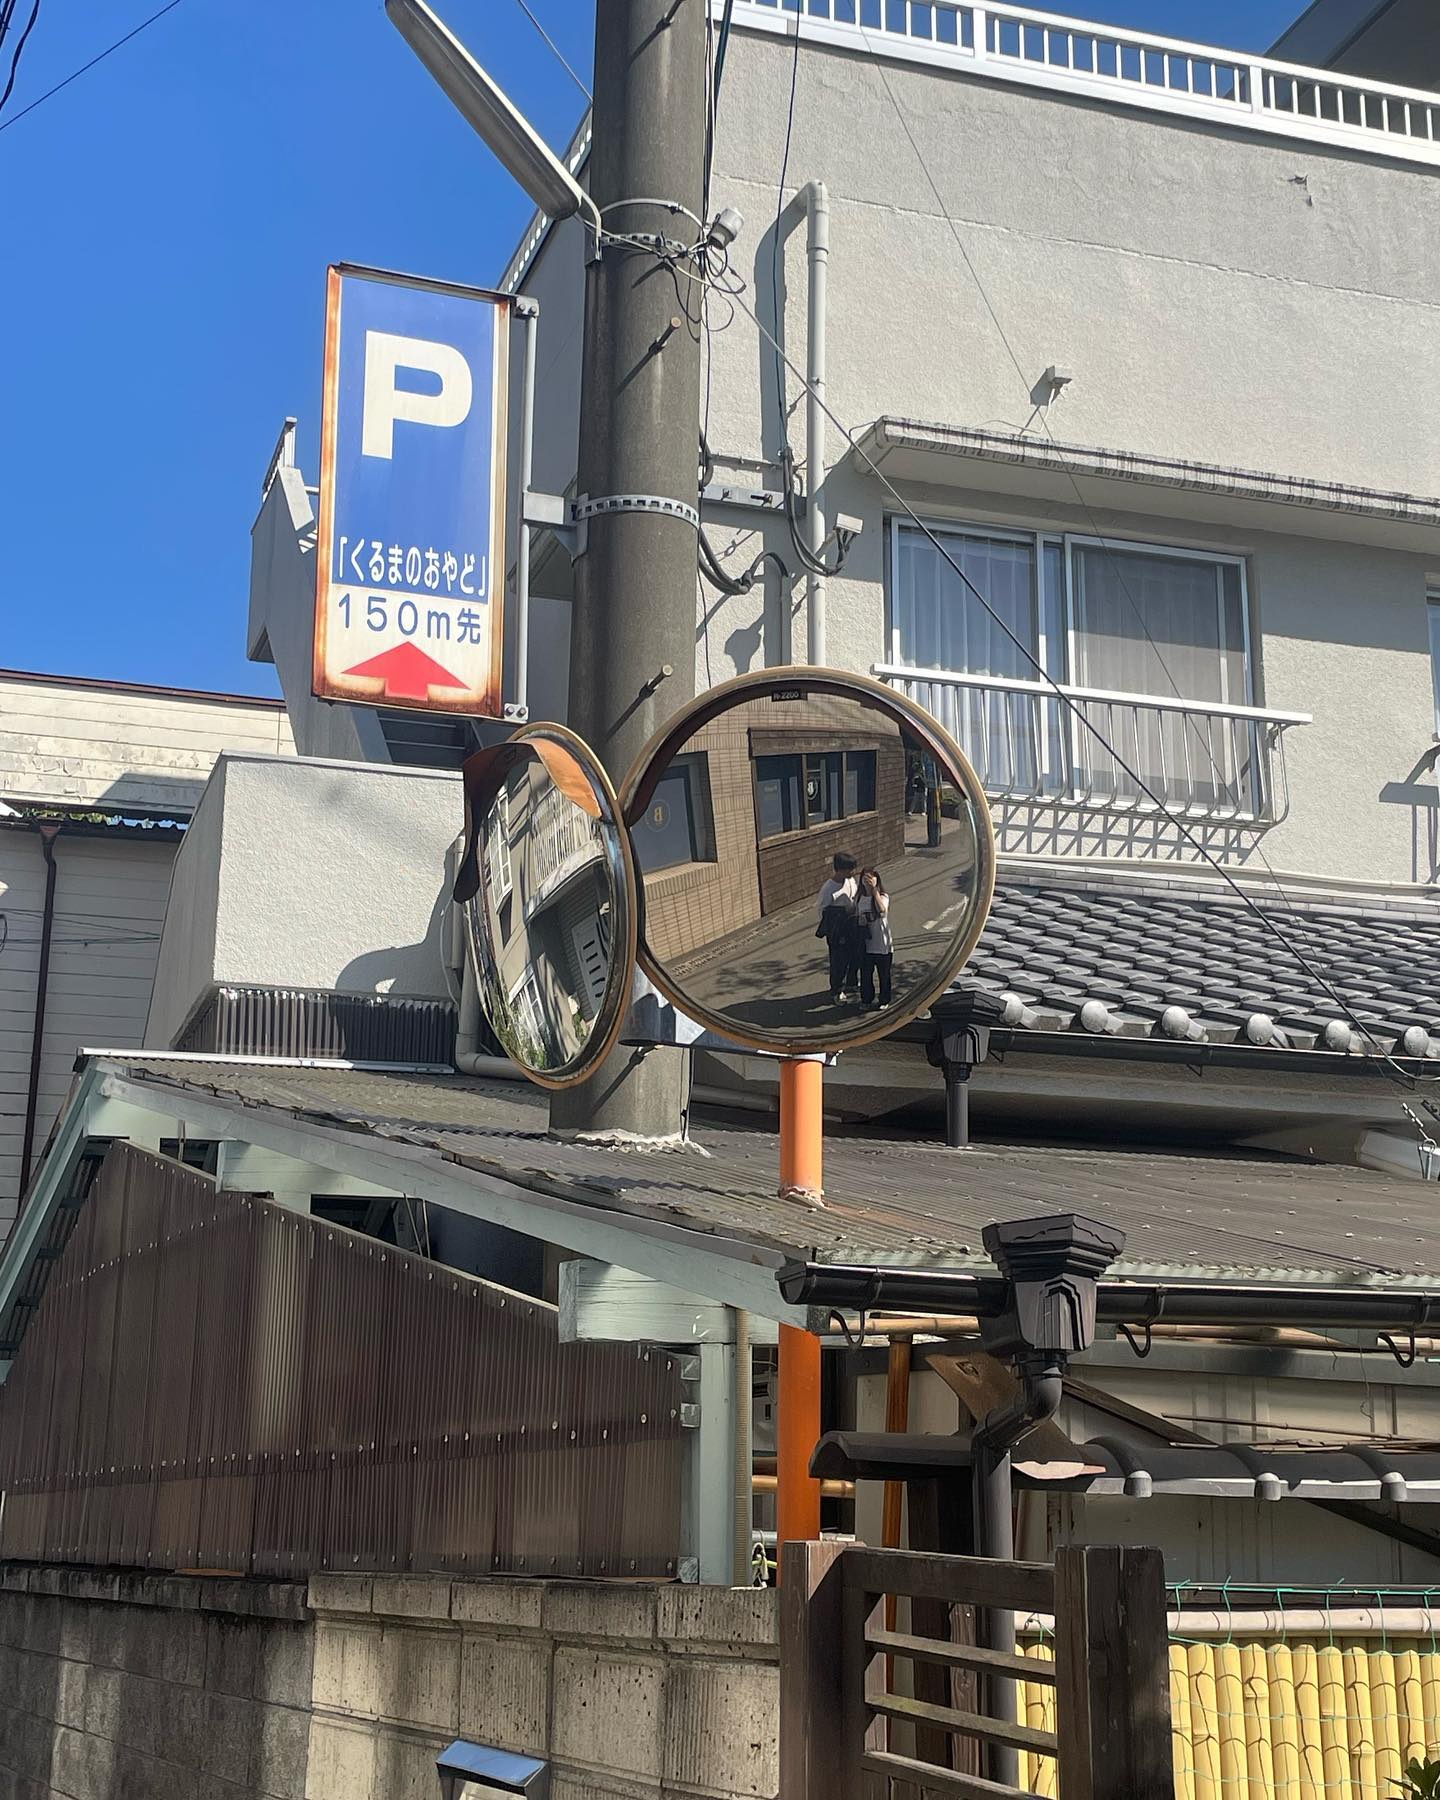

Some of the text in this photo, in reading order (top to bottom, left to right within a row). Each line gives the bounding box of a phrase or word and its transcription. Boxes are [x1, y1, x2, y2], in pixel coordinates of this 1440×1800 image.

[361, 329, 473, 460] P
[338, 536, 487, 598] 「くるまのおやど」
